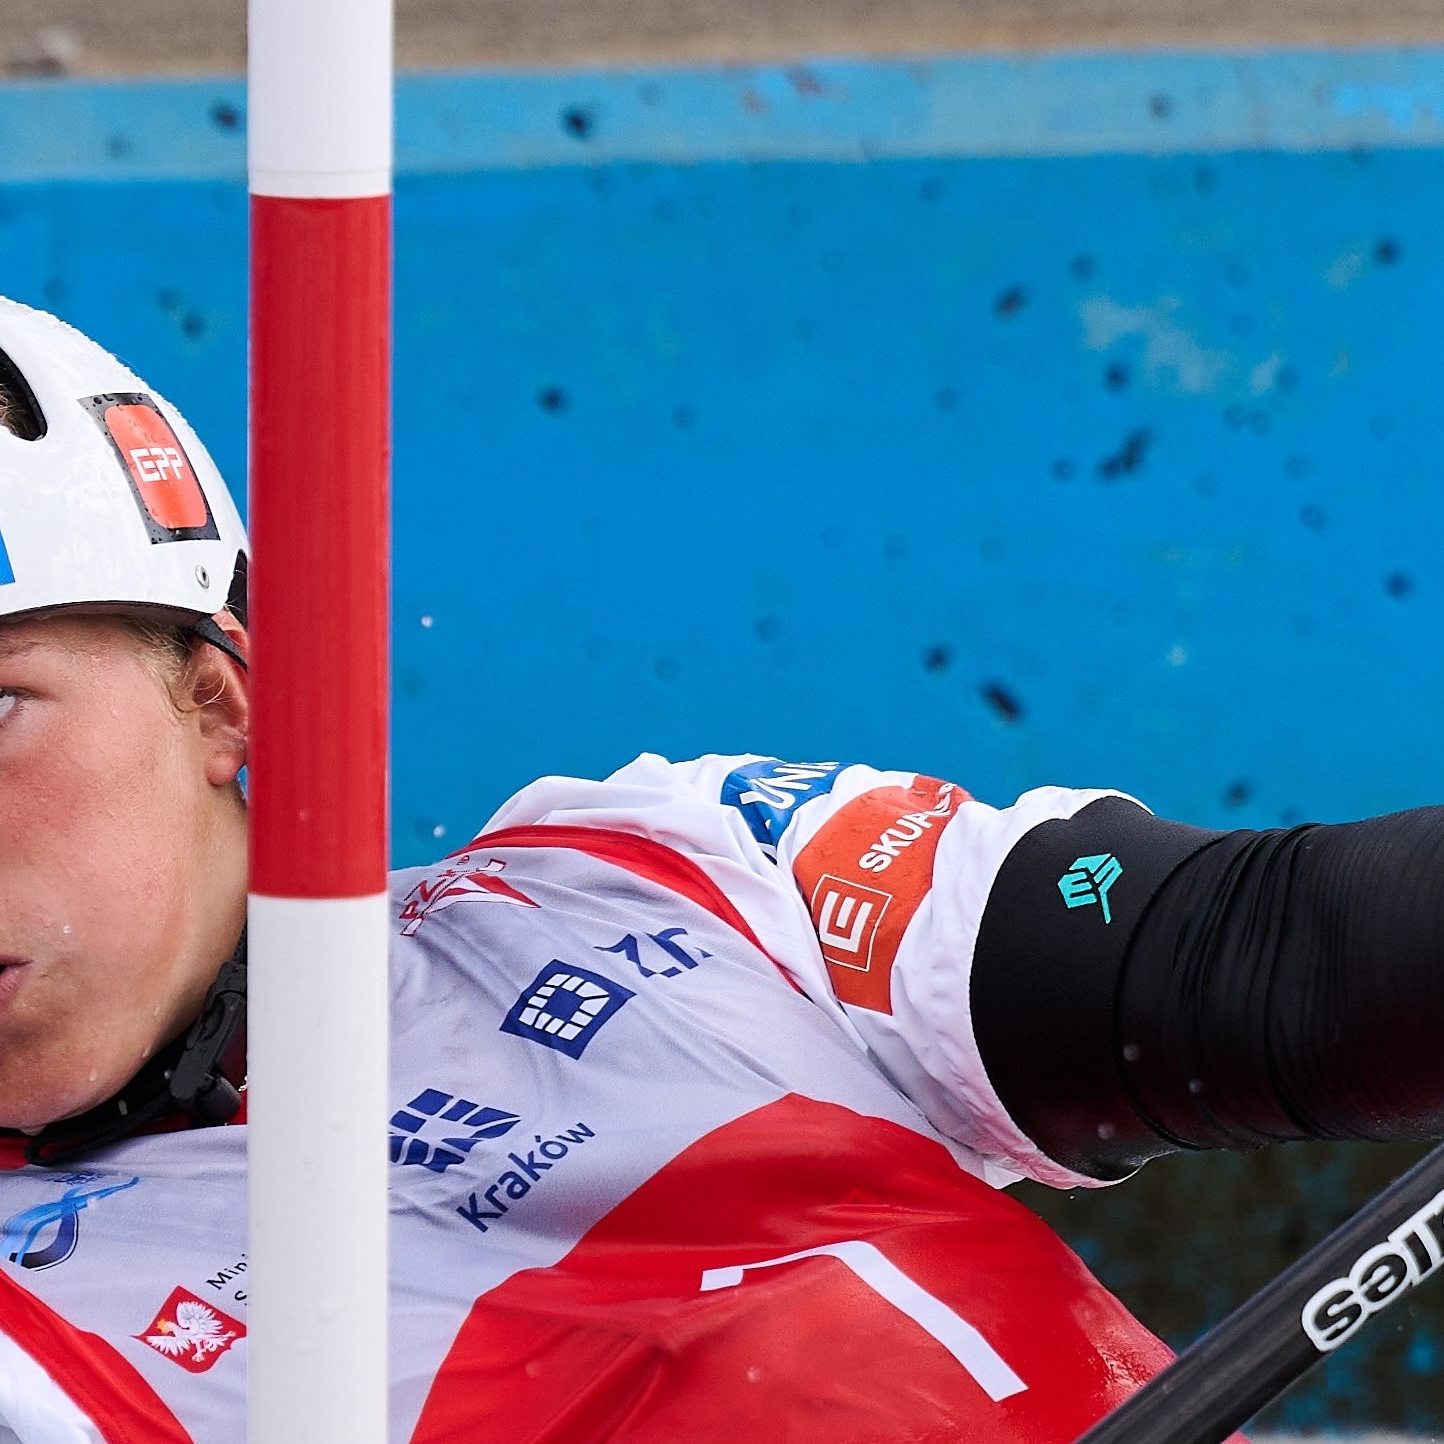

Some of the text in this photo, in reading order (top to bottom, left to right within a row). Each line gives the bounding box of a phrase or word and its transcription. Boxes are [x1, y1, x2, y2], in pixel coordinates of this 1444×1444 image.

[740, 762, 840, 810] UNI
[456, 1122, 596, 1233] Kraków
[206, 1253, 248, 1290] Min
